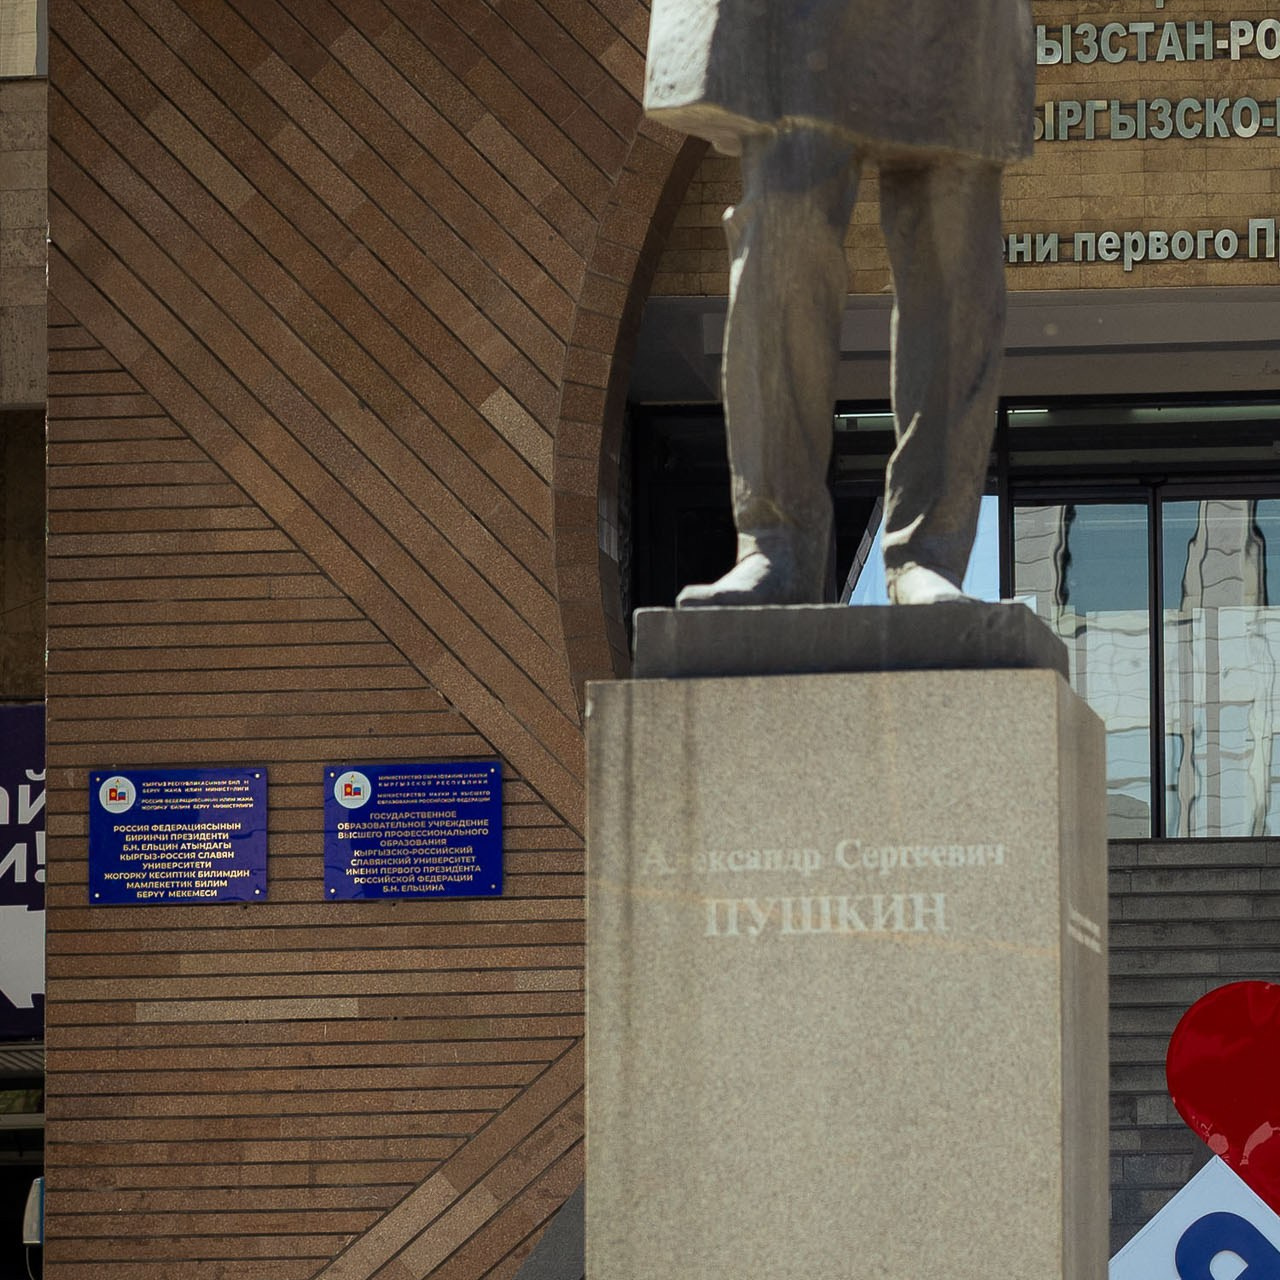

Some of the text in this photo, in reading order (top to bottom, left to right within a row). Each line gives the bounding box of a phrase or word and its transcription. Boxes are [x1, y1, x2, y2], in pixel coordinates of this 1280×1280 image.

[1000, 231, 1059, 262] ни
[1073, 228, 1238, 271] первого
[370, 810, 457, 820] ГОСУДАРСТВЕННОЕ
[113, 822, 241, 832] РОССИЯ ФЕДЕРАЦИЯСЫНЫН
[337, 819, 489, 830] ОБРАЗОВАТЕЛЬНОЕ УЧРЕЖДЕНИЕ
[125, 832, 229, 842] БИРИНЧИ ПРЕЗИДЕНТИ
[337, 828, 489, 839] ВЫСШЕГО ПРОФЕССИОНАЛЬНОГО
[141, 843, 178, 852] ЕЛЬЦИН
[180, 842, 232, 851] АТЫНДАГЫ
[379, 838, 447, 847] ОБРАЗОВАНИЯ
[197, 851, 235, 859] СЛАВЯН
[640, 837, 1006, 878] Аександр Сергеевич
[142, 861, 212, 870] УНИВЕРСИТЕТИ
[350, 856, 477, 866] СЛАВЯНСКИЙ УНИВЕРСИТЕТ
[104, 869, 250, 880] ЖОГОРКУ КЕСИПТИК БИЛИМДИН
[345, 865, 481, 876] ИМЕНИ ПЕРВОГО ПРЕЗИДЕНТА
[126, 879, 228, 889] МАМЛЕКЕТТИК БИЛИМ
[354, 875, 473, 884] РОССИЙСКОЙ ФЕДЕРАЦИИ
[401, 883, 445, 892] ЕЛЬЦИНА
[168, 889, 217, 897] МЕКЕМЕСИ
[703, 892, 950, 938] ПУШКИН
